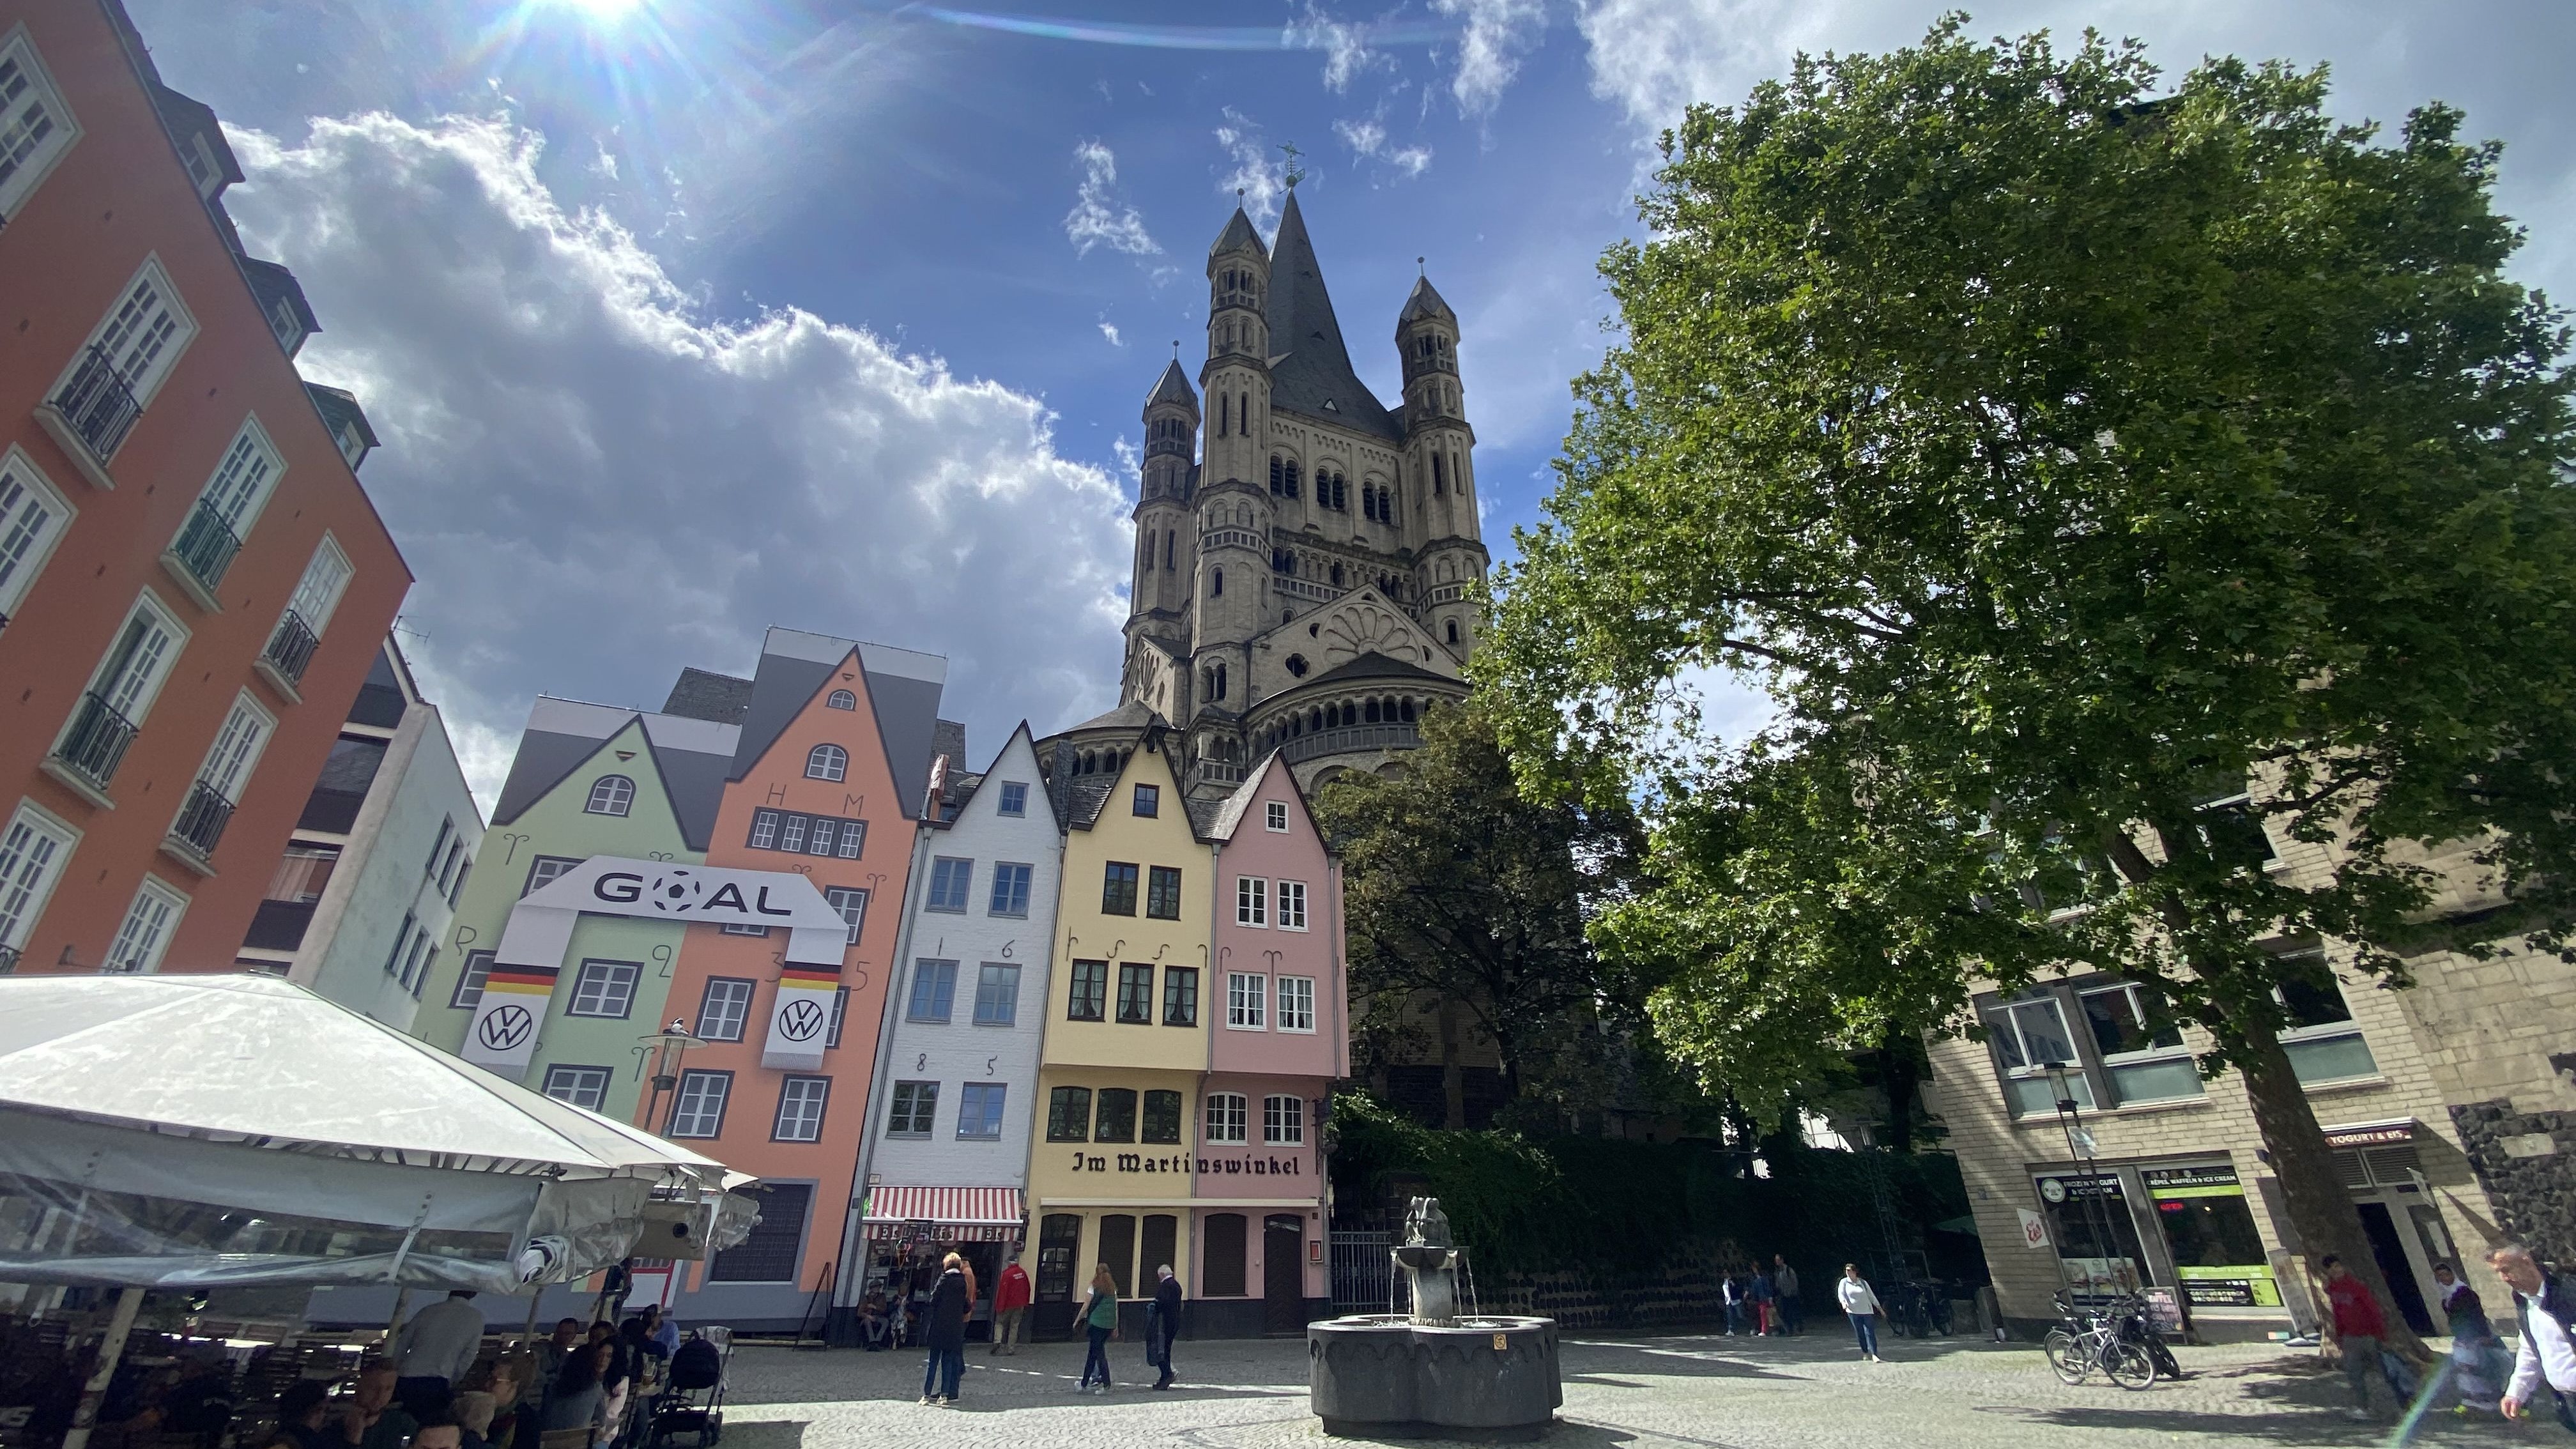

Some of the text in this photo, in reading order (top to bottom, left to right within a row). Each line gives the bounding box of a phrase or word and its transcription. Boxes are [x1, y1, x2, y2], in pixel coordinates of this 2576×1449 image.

[2330, 1130, 2404, 1144] YOGURT & EIS
[1072, 1151, 1300, 1175] Im Martinswinkel
[2089, 1179, 2118, 1187] YGURT
